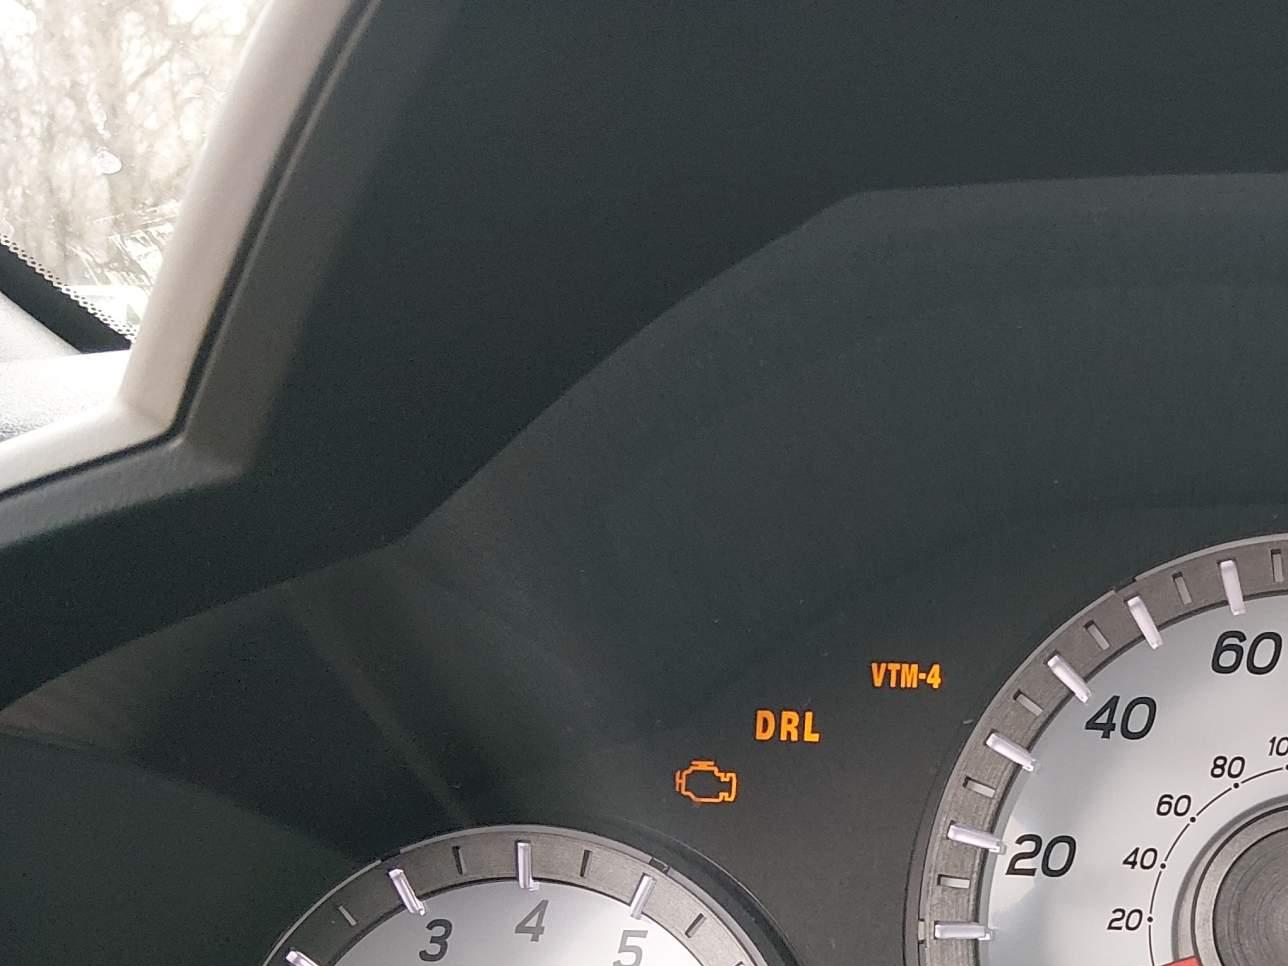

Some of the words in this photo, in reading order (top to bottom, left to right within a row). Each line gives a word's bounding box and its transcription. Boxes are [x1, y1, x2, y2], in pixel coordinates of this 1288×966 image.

[1211, 631, 1282, 675] 60
[871, 662, 941, 688] VTM-4
[755, 710, 821, 742] DRL
[1085, 695, 1156, 741] 40
[1209, 756, 1246, 778] 80
[1156, 794, 1192, 817] 60
[1006, 835, 1077, 878] 20
[1122, 848, 1158, 870] 40
[515, 900, 548, 942] 4
[1107, 908, 1143, 931] 20
[419, 919, 453, 962] 3
